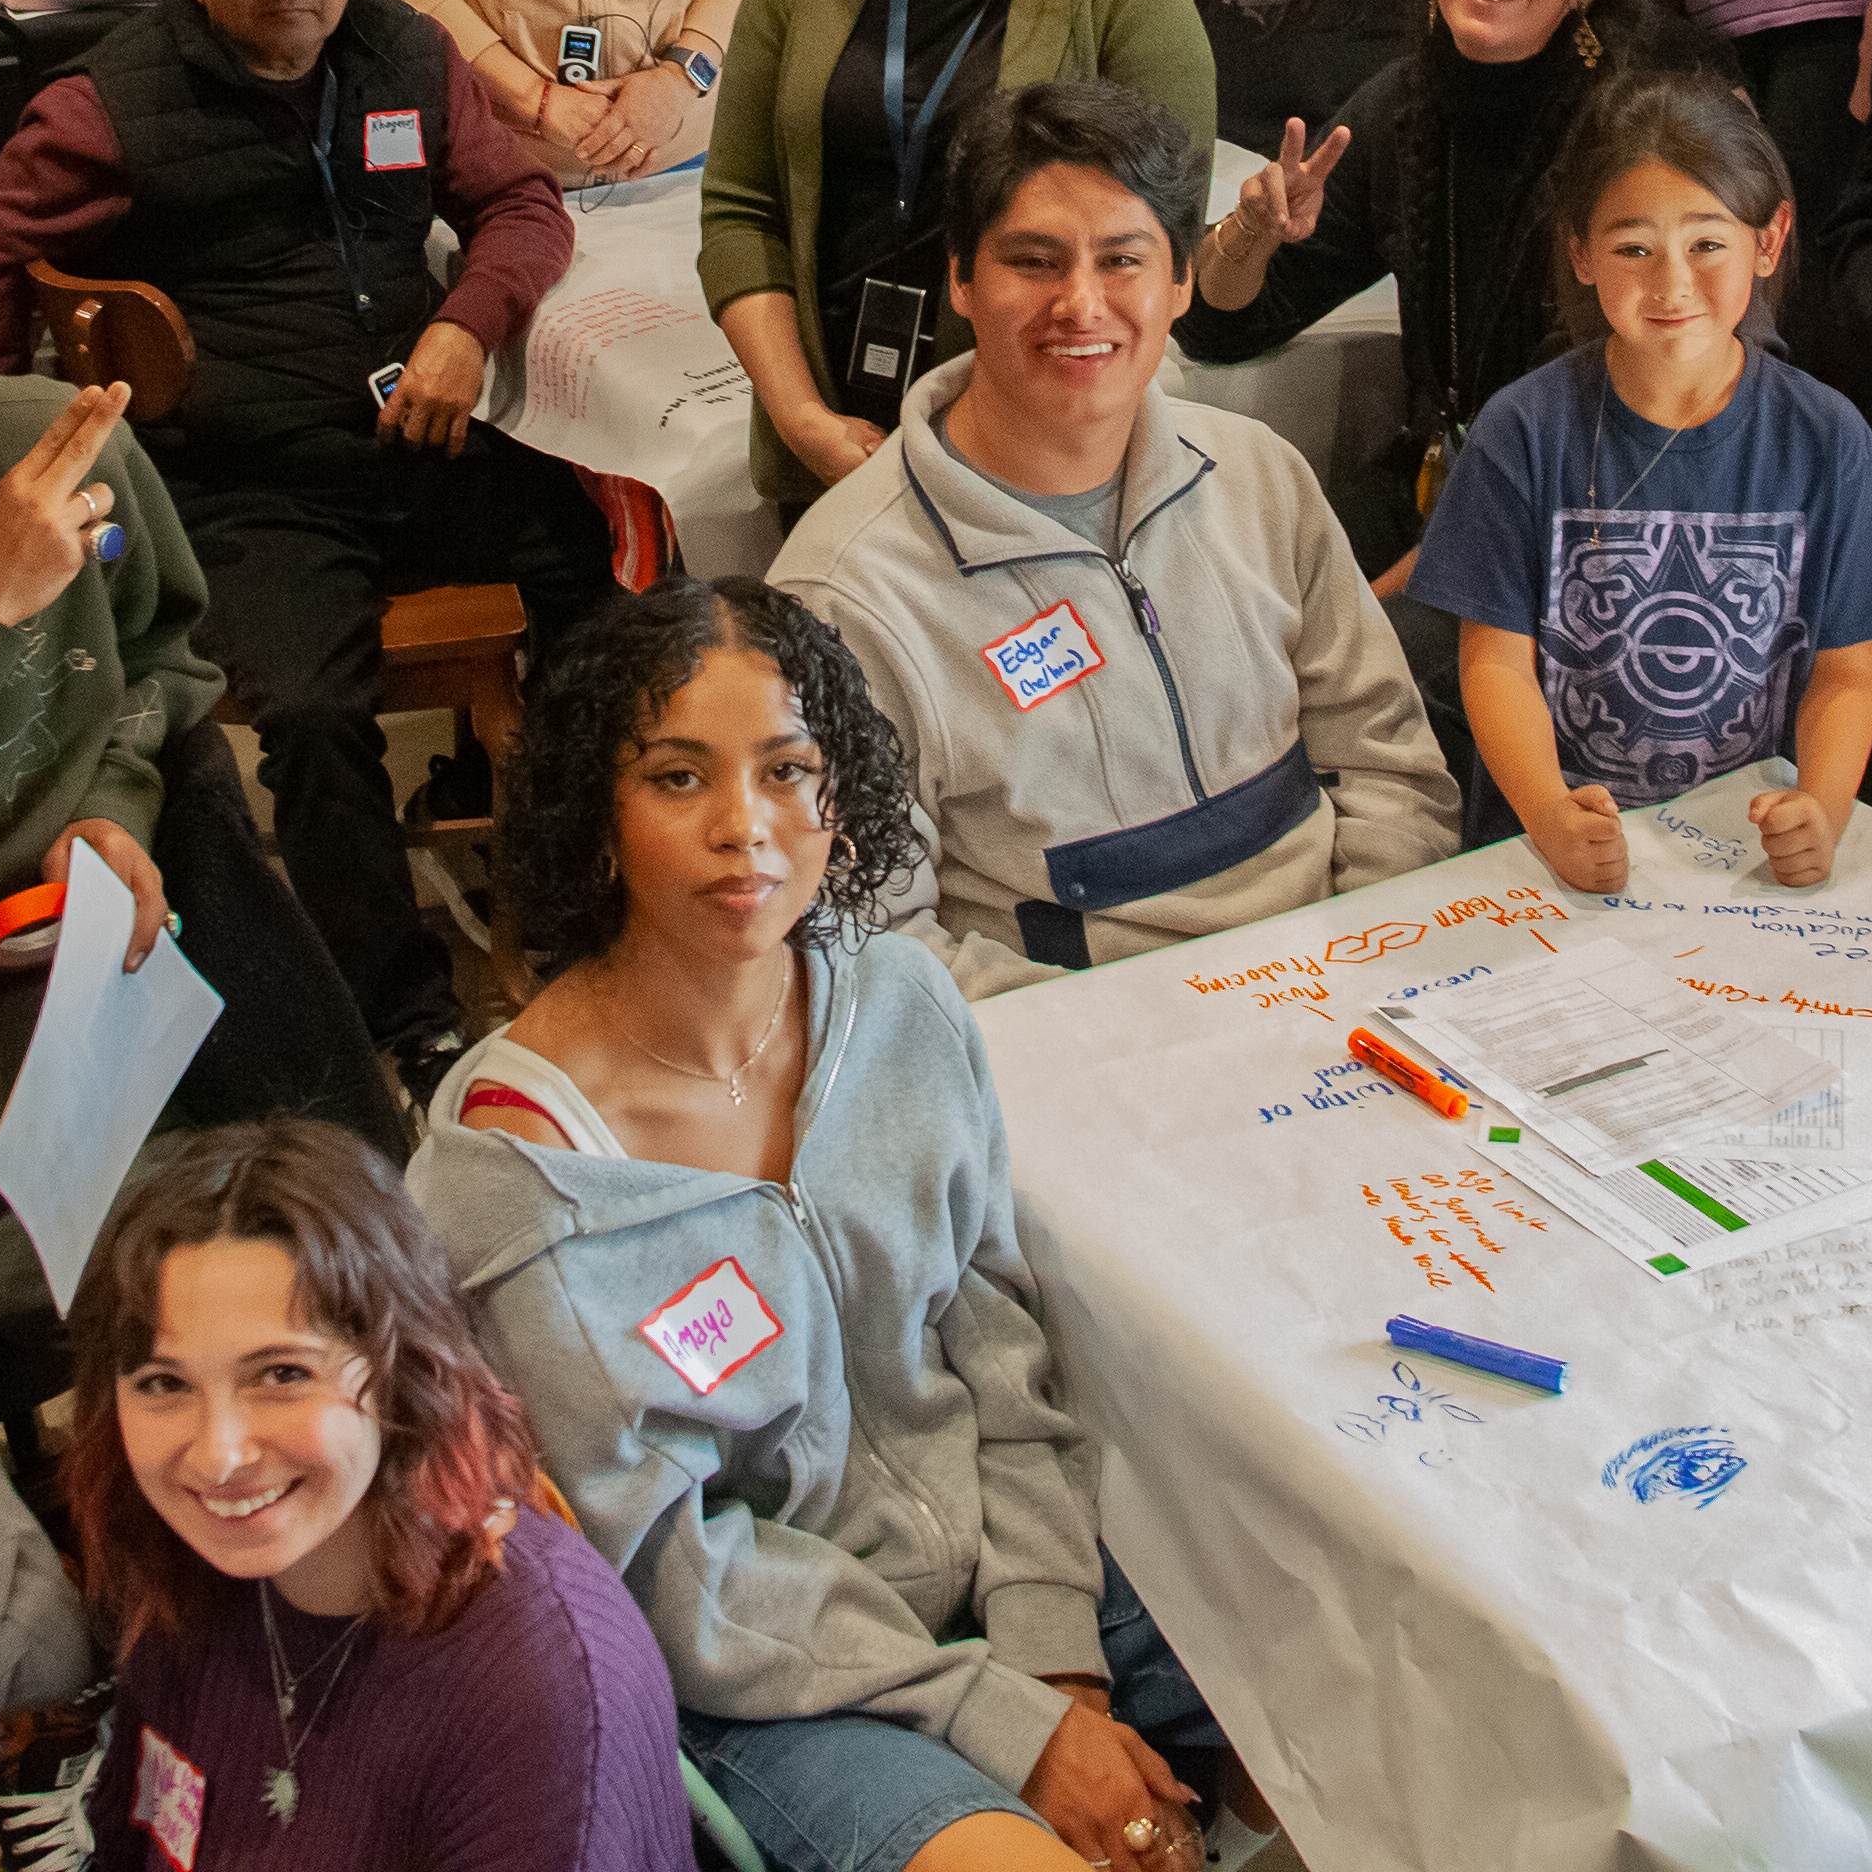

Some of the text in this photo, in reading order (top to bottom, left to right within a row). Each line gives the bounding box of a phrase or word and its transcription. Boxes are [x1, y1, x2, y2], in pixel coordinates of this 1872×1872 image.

[996, 625, 1062, 675] Edgar
[1654, 806, 1749, 858] ageism
[1693, 851, 1741, 871] No
[1432, 886, 1545, 929] to learn
[1487, 902, 1571, 928] Easy
[1251, 981, 1330, 1010] Music
[1257, 1102, 1295, 1126] of
